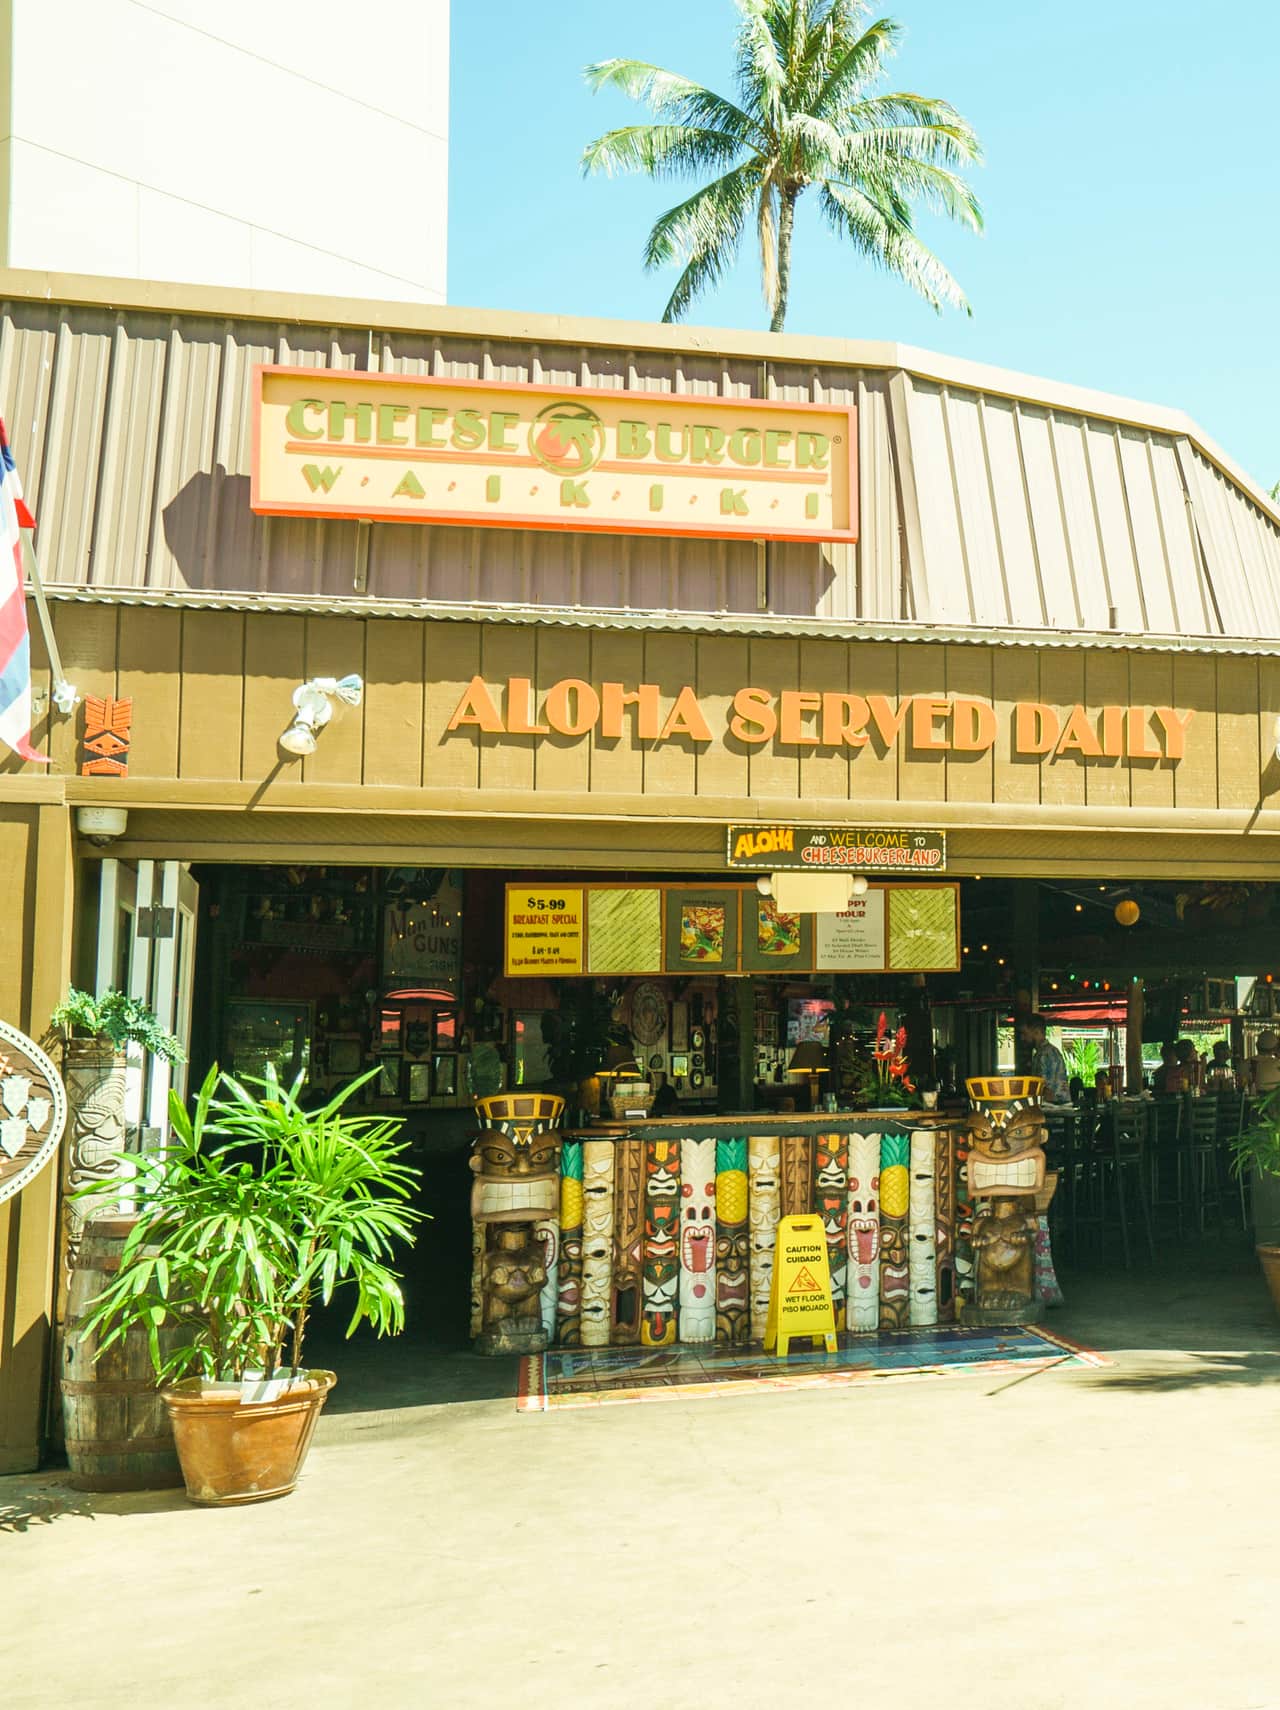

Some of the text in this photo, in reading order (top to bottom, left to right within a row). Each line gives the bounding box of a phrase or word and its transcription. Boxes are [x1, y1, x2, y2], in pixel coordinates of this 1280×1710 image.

[286, 398, 830, 471] CHEESE BURGER
[447, 675, 1196, 761] ALOHA SERVED DAILY
[734, 830, 795, 858] ALOHA
[809, 832, 926, 848] AND WELCOME TO
[801, 846, 941, 865] CHEESEBURGERLAND
[512, 914, 578, 925] BREAKFAST SPECIAL
[414, 934, 458, 955] GUNS
[785, 1245, 822, 1253] CAUTION
[786, 1255, 822, 1263] CUIDADO
[801, 1294, 825, 1303] FLOOR
[782, 1303, 830, 1313] PISO MOJADO
